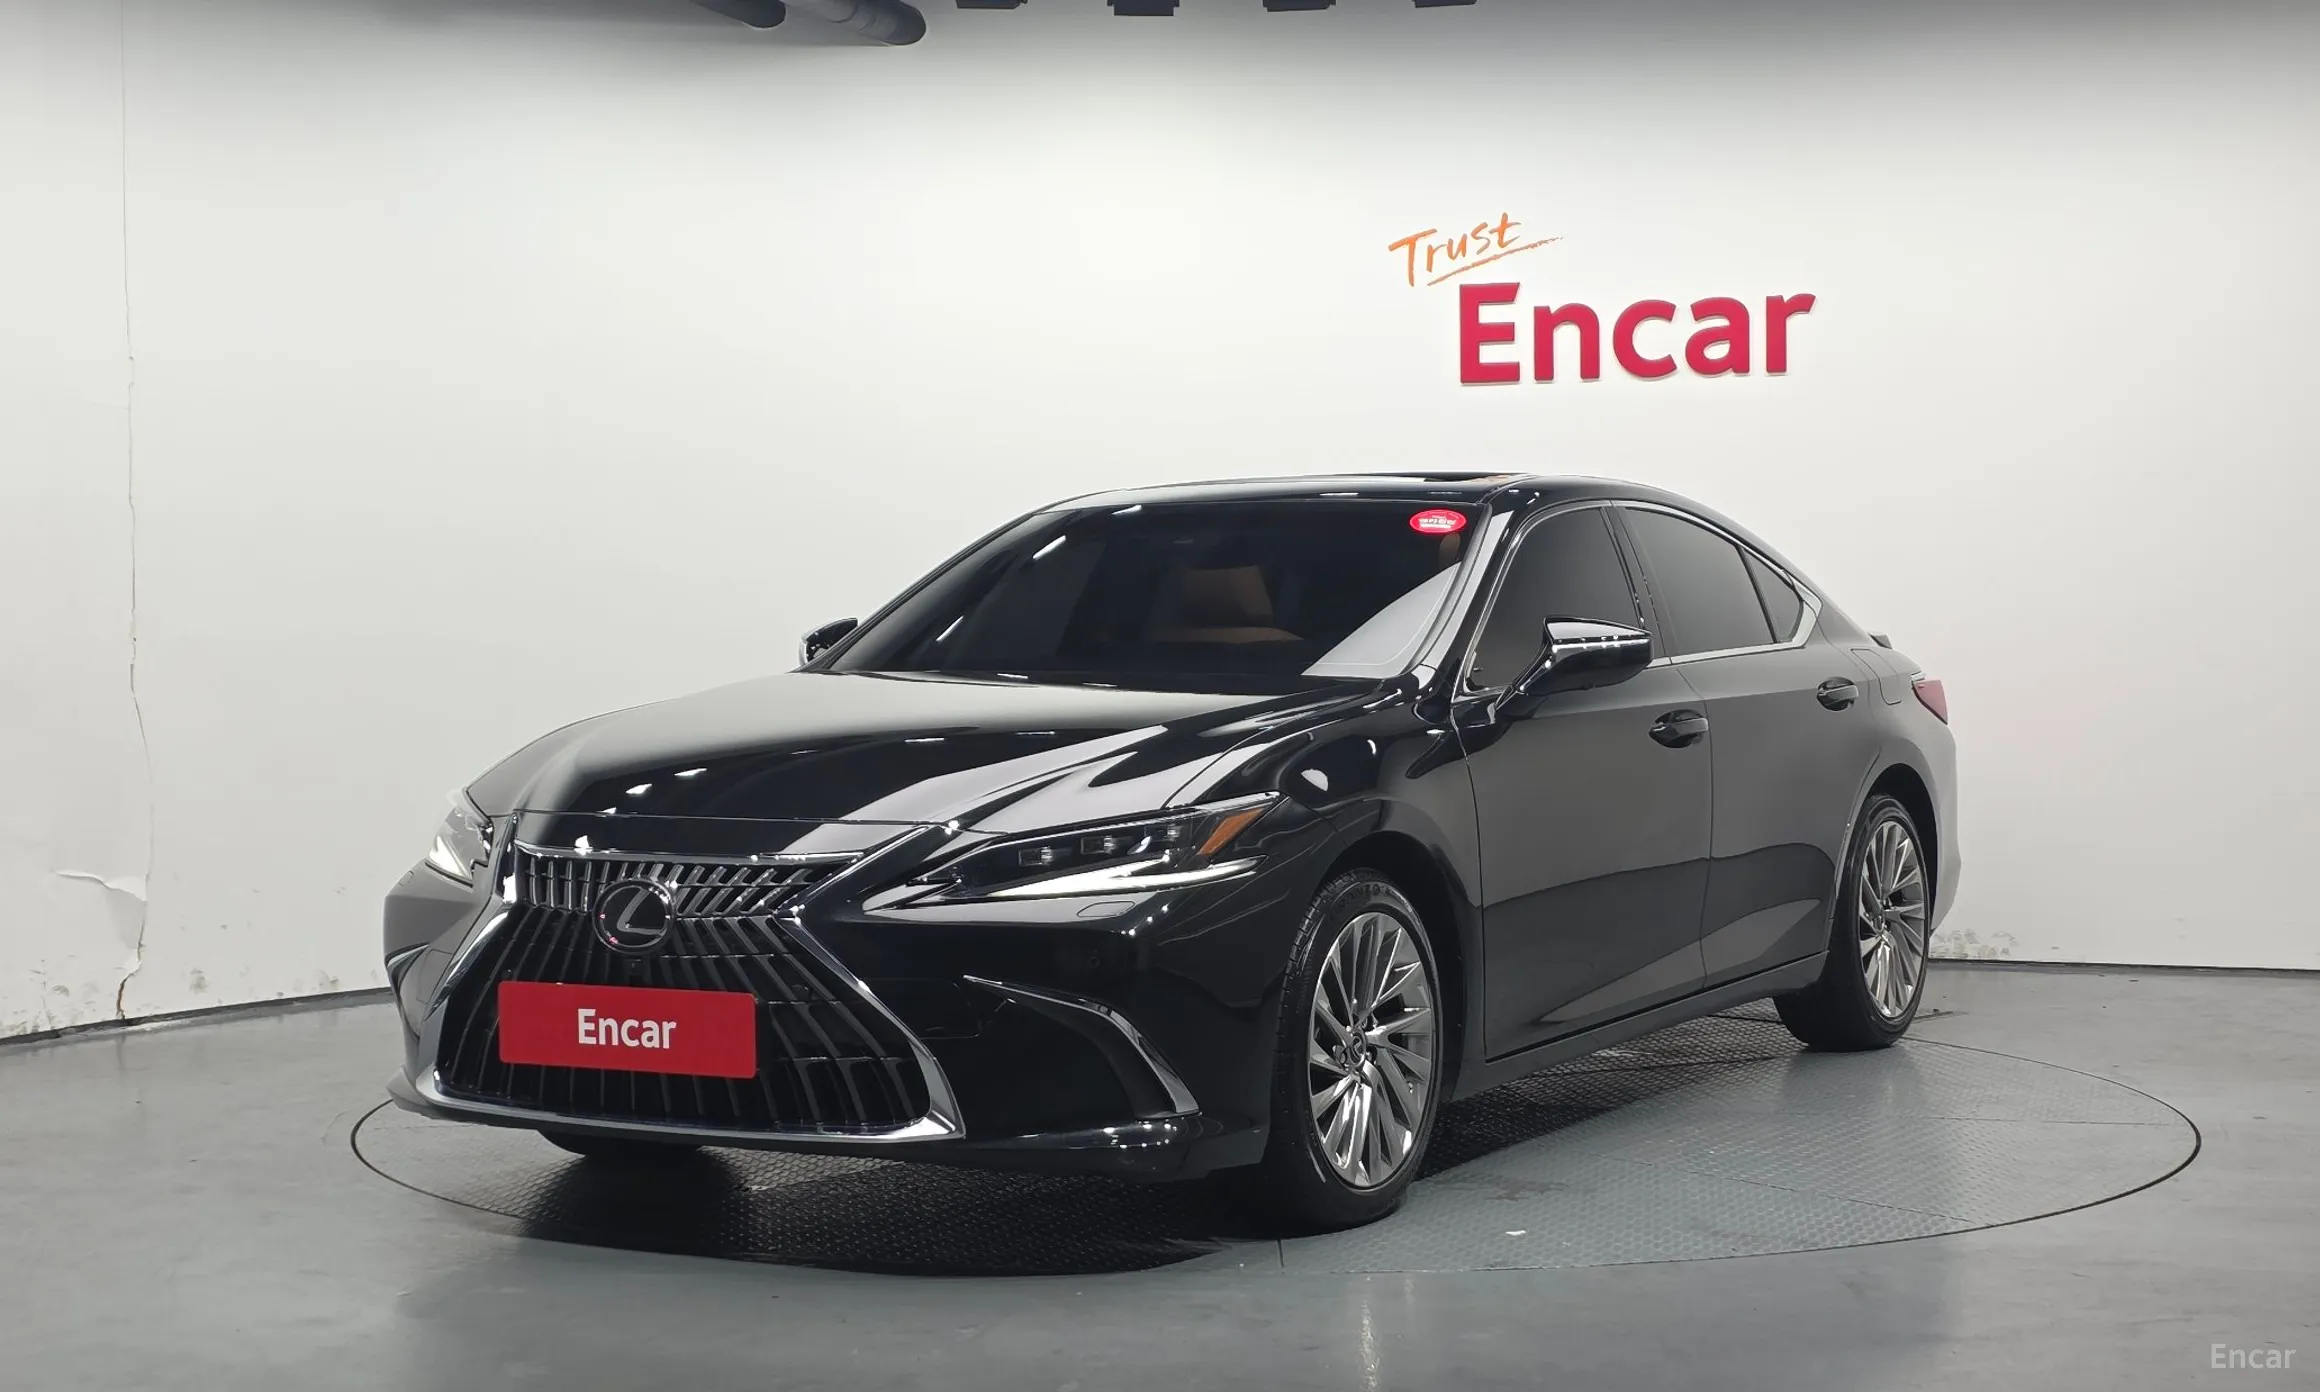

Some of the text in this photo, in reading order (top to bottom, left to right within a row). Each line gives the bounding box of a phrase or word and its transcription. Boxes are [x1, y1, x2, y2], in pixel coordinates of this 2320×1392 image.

[1389, 212, 1522, 287] Trust
[1459, 282, 1816, 384] Encar
[577, 1008, 677, 1049] Encar
